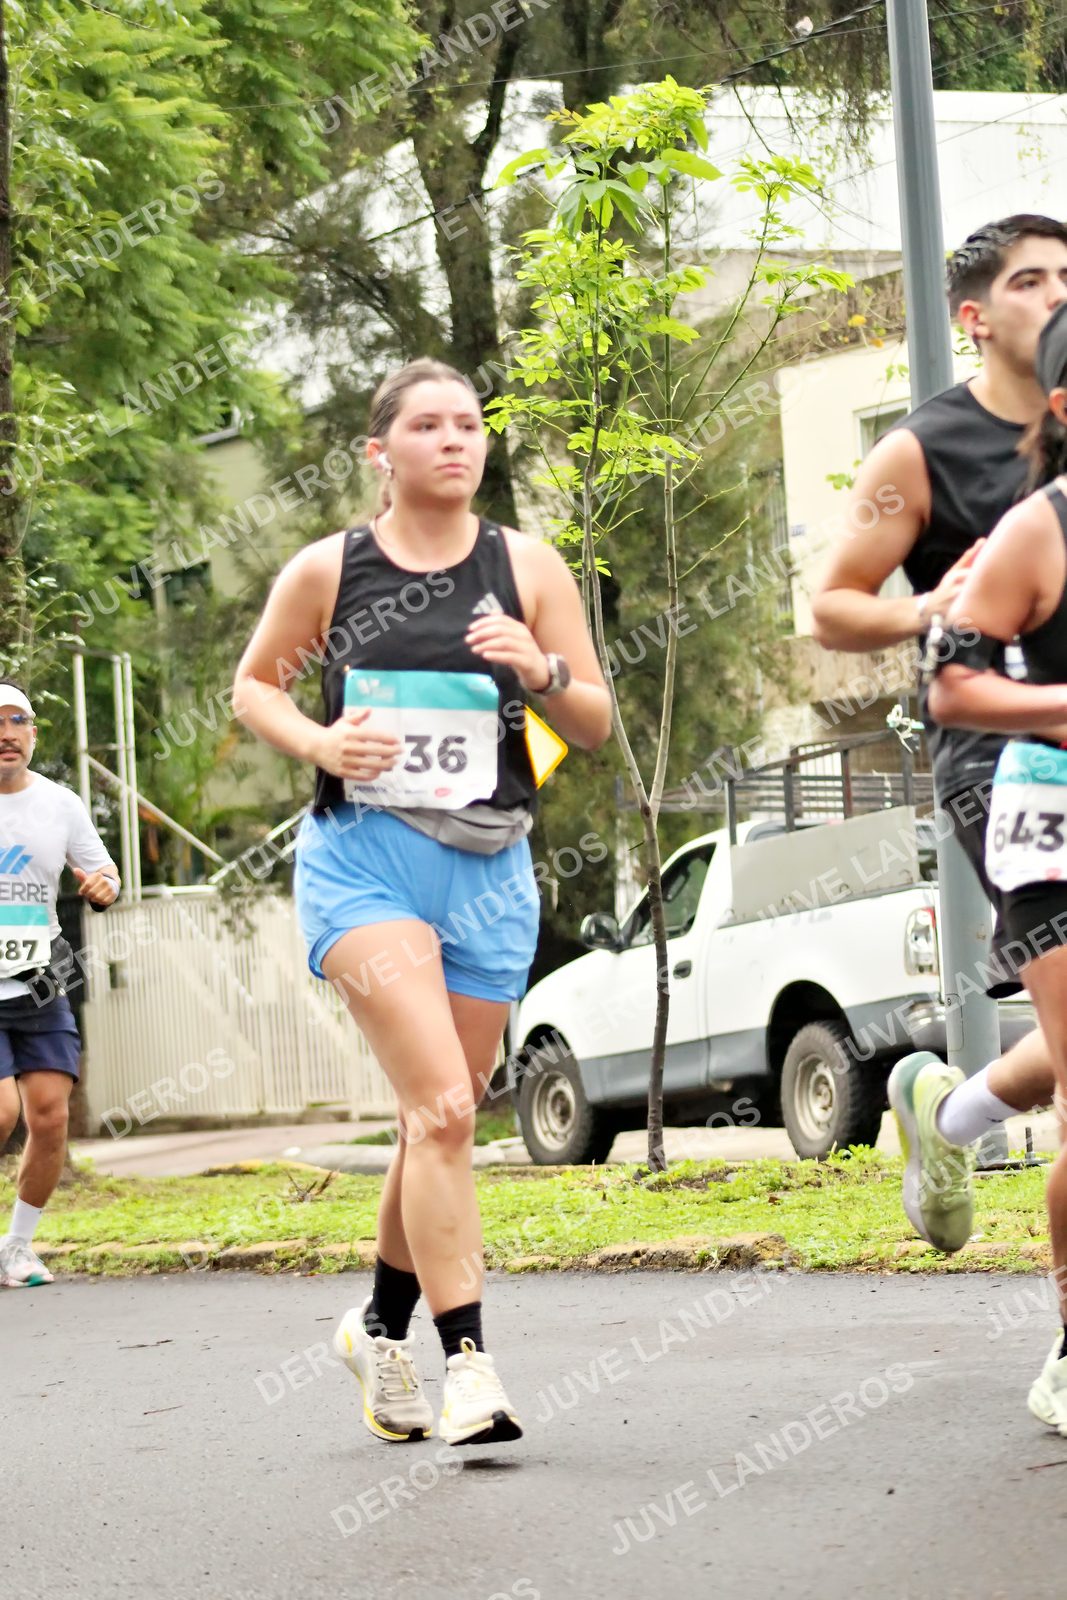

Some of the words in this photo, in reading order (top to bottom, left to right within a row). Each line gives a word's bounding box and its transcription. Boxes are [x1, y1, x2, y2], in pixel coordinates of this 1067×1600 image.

[403, 735, 468, 774] 36
[994, 811, 1065, 853] 643
[0, 939, 39, 961] 87
